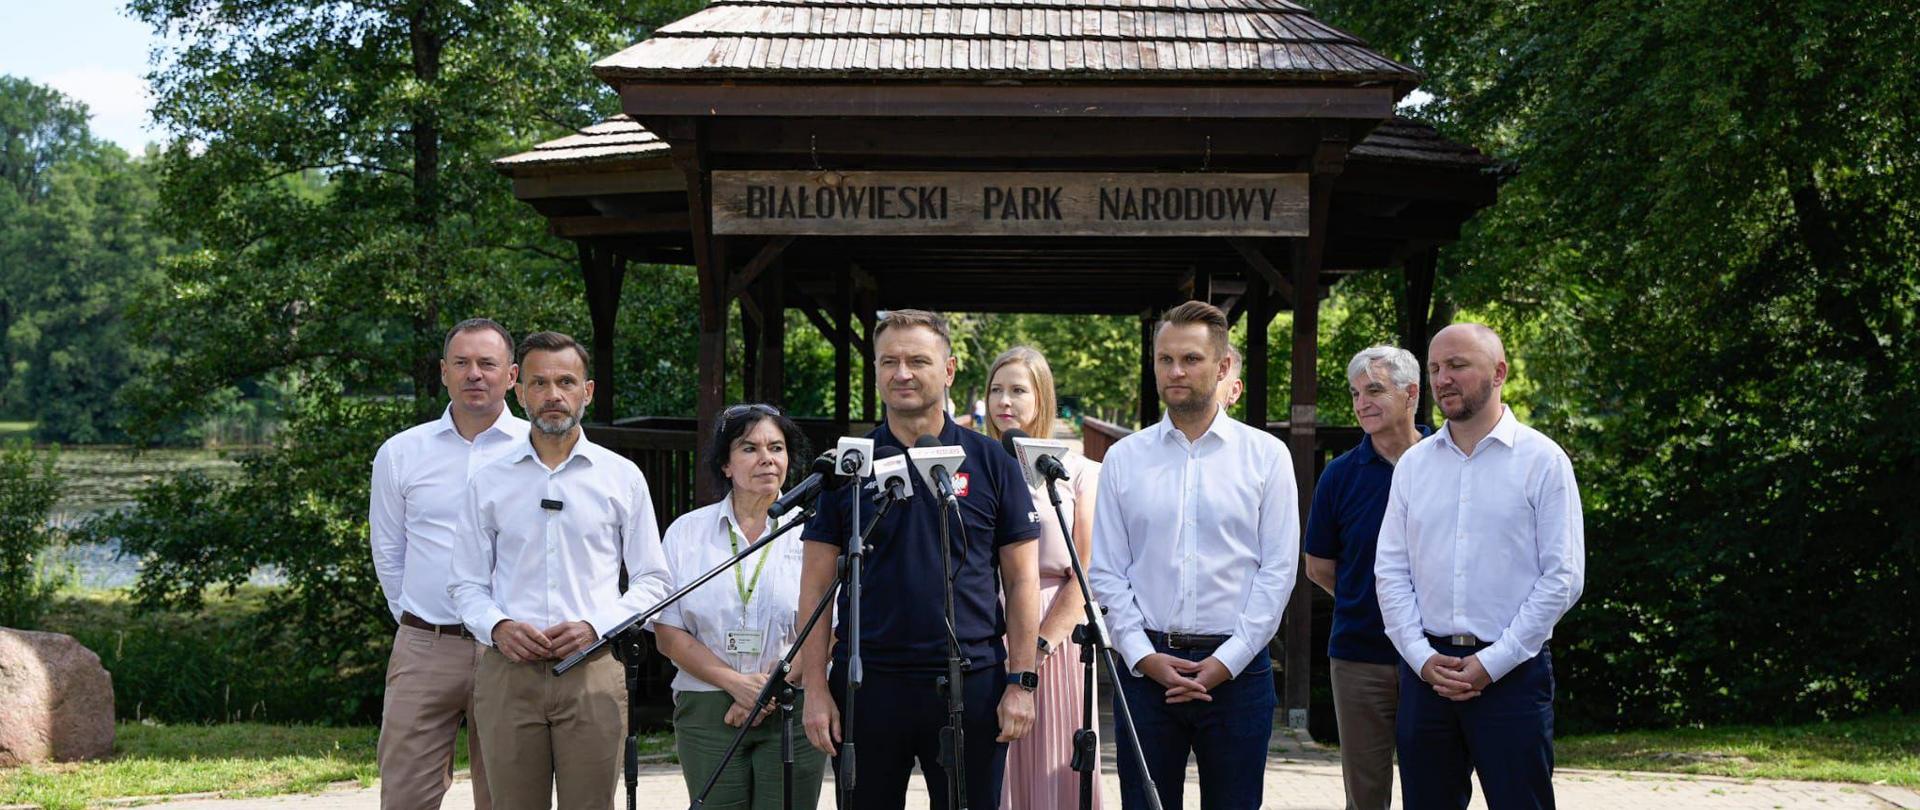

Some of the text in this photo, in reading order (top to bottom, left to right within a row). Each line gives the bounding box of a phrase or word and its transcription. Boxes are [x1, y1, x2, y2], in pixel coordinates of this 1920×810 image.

[746, 185, 1277, 222] BIAŁOWIESKI PARK NARODOWY
